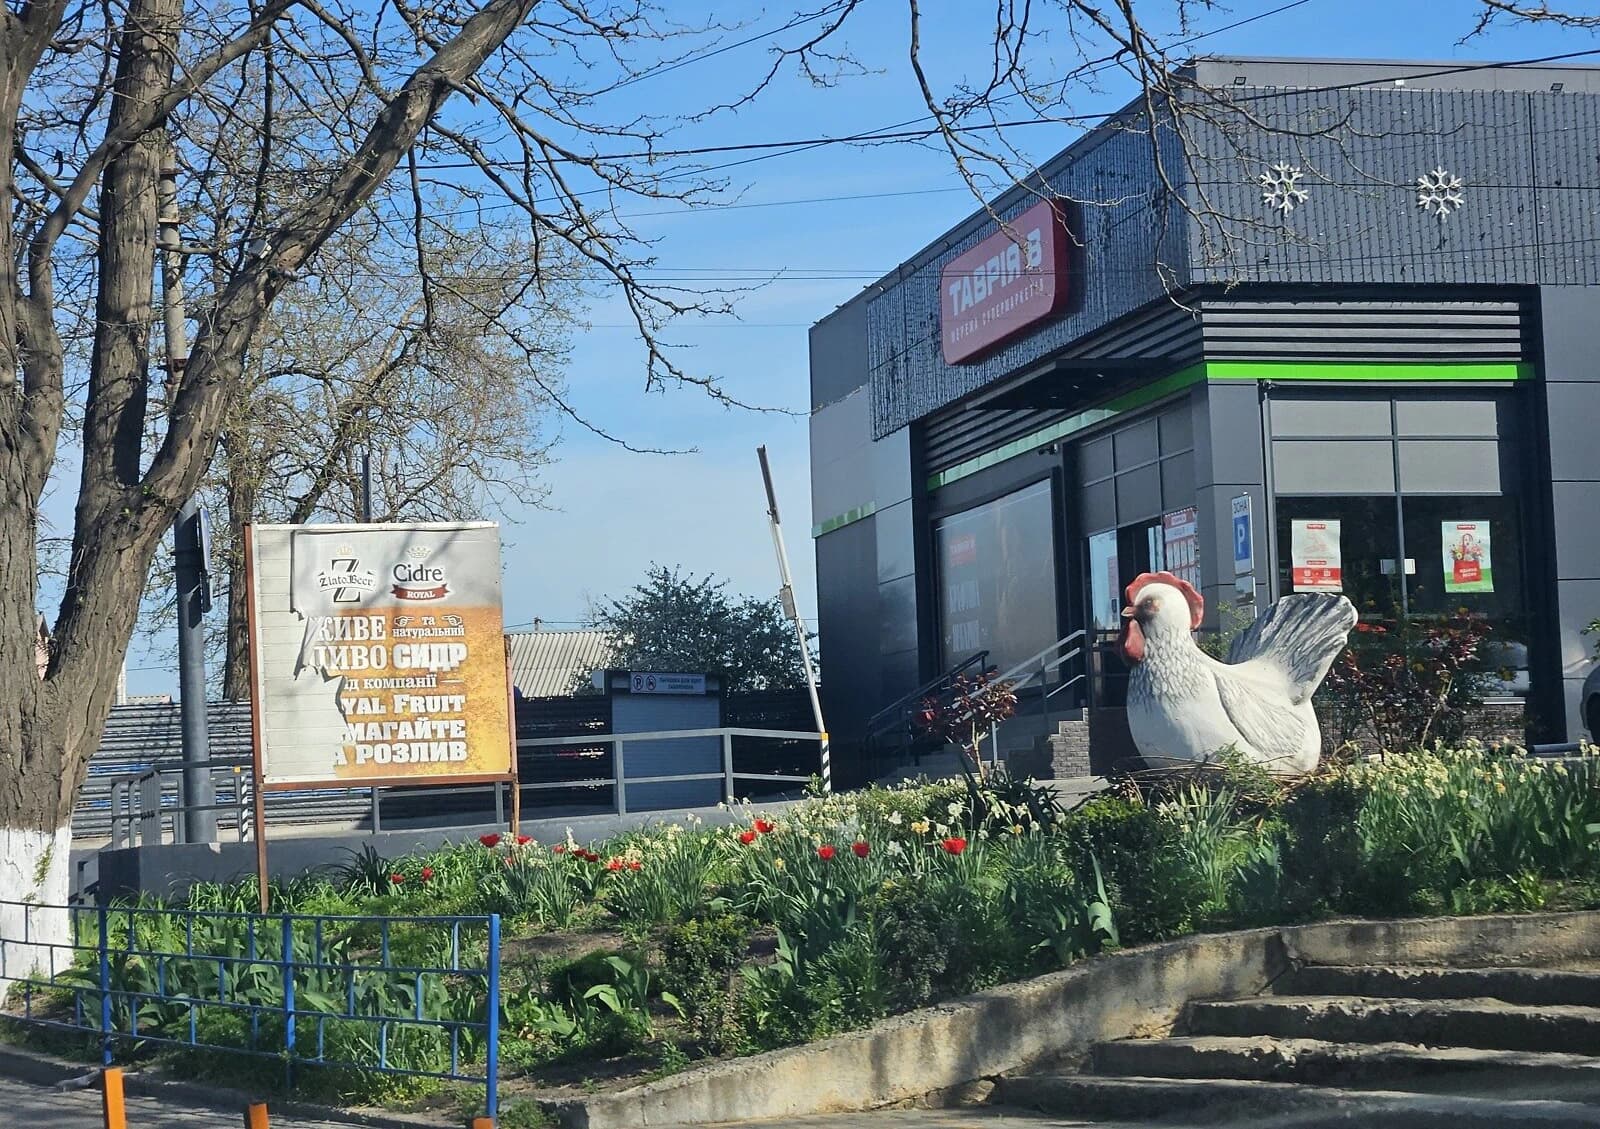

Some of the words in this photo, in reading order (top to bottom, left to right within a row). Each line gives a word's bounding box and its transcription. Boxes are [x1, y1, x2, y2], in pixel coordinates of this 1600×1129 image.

[949, 242, 1021, 317] ТАВРІЯ
[393, 563, 443, 583] Cidre
[406, 590, 436, 600] ROYAL
[421, 615, 435, 626] та
[392, 625, 465, 639] натуральний
[393, 643, 468, 672] СИДР
[344, 676, 360, 691] ід
[363, 673, 437, 690] компанії
[340, 697, 387, 715] YAL
[393, 693, 467, 713] FRUIT
[341, 716, 467, 745] МАГАЙТЕ
[355, 741, 468, 765] РОЗЛИВ
